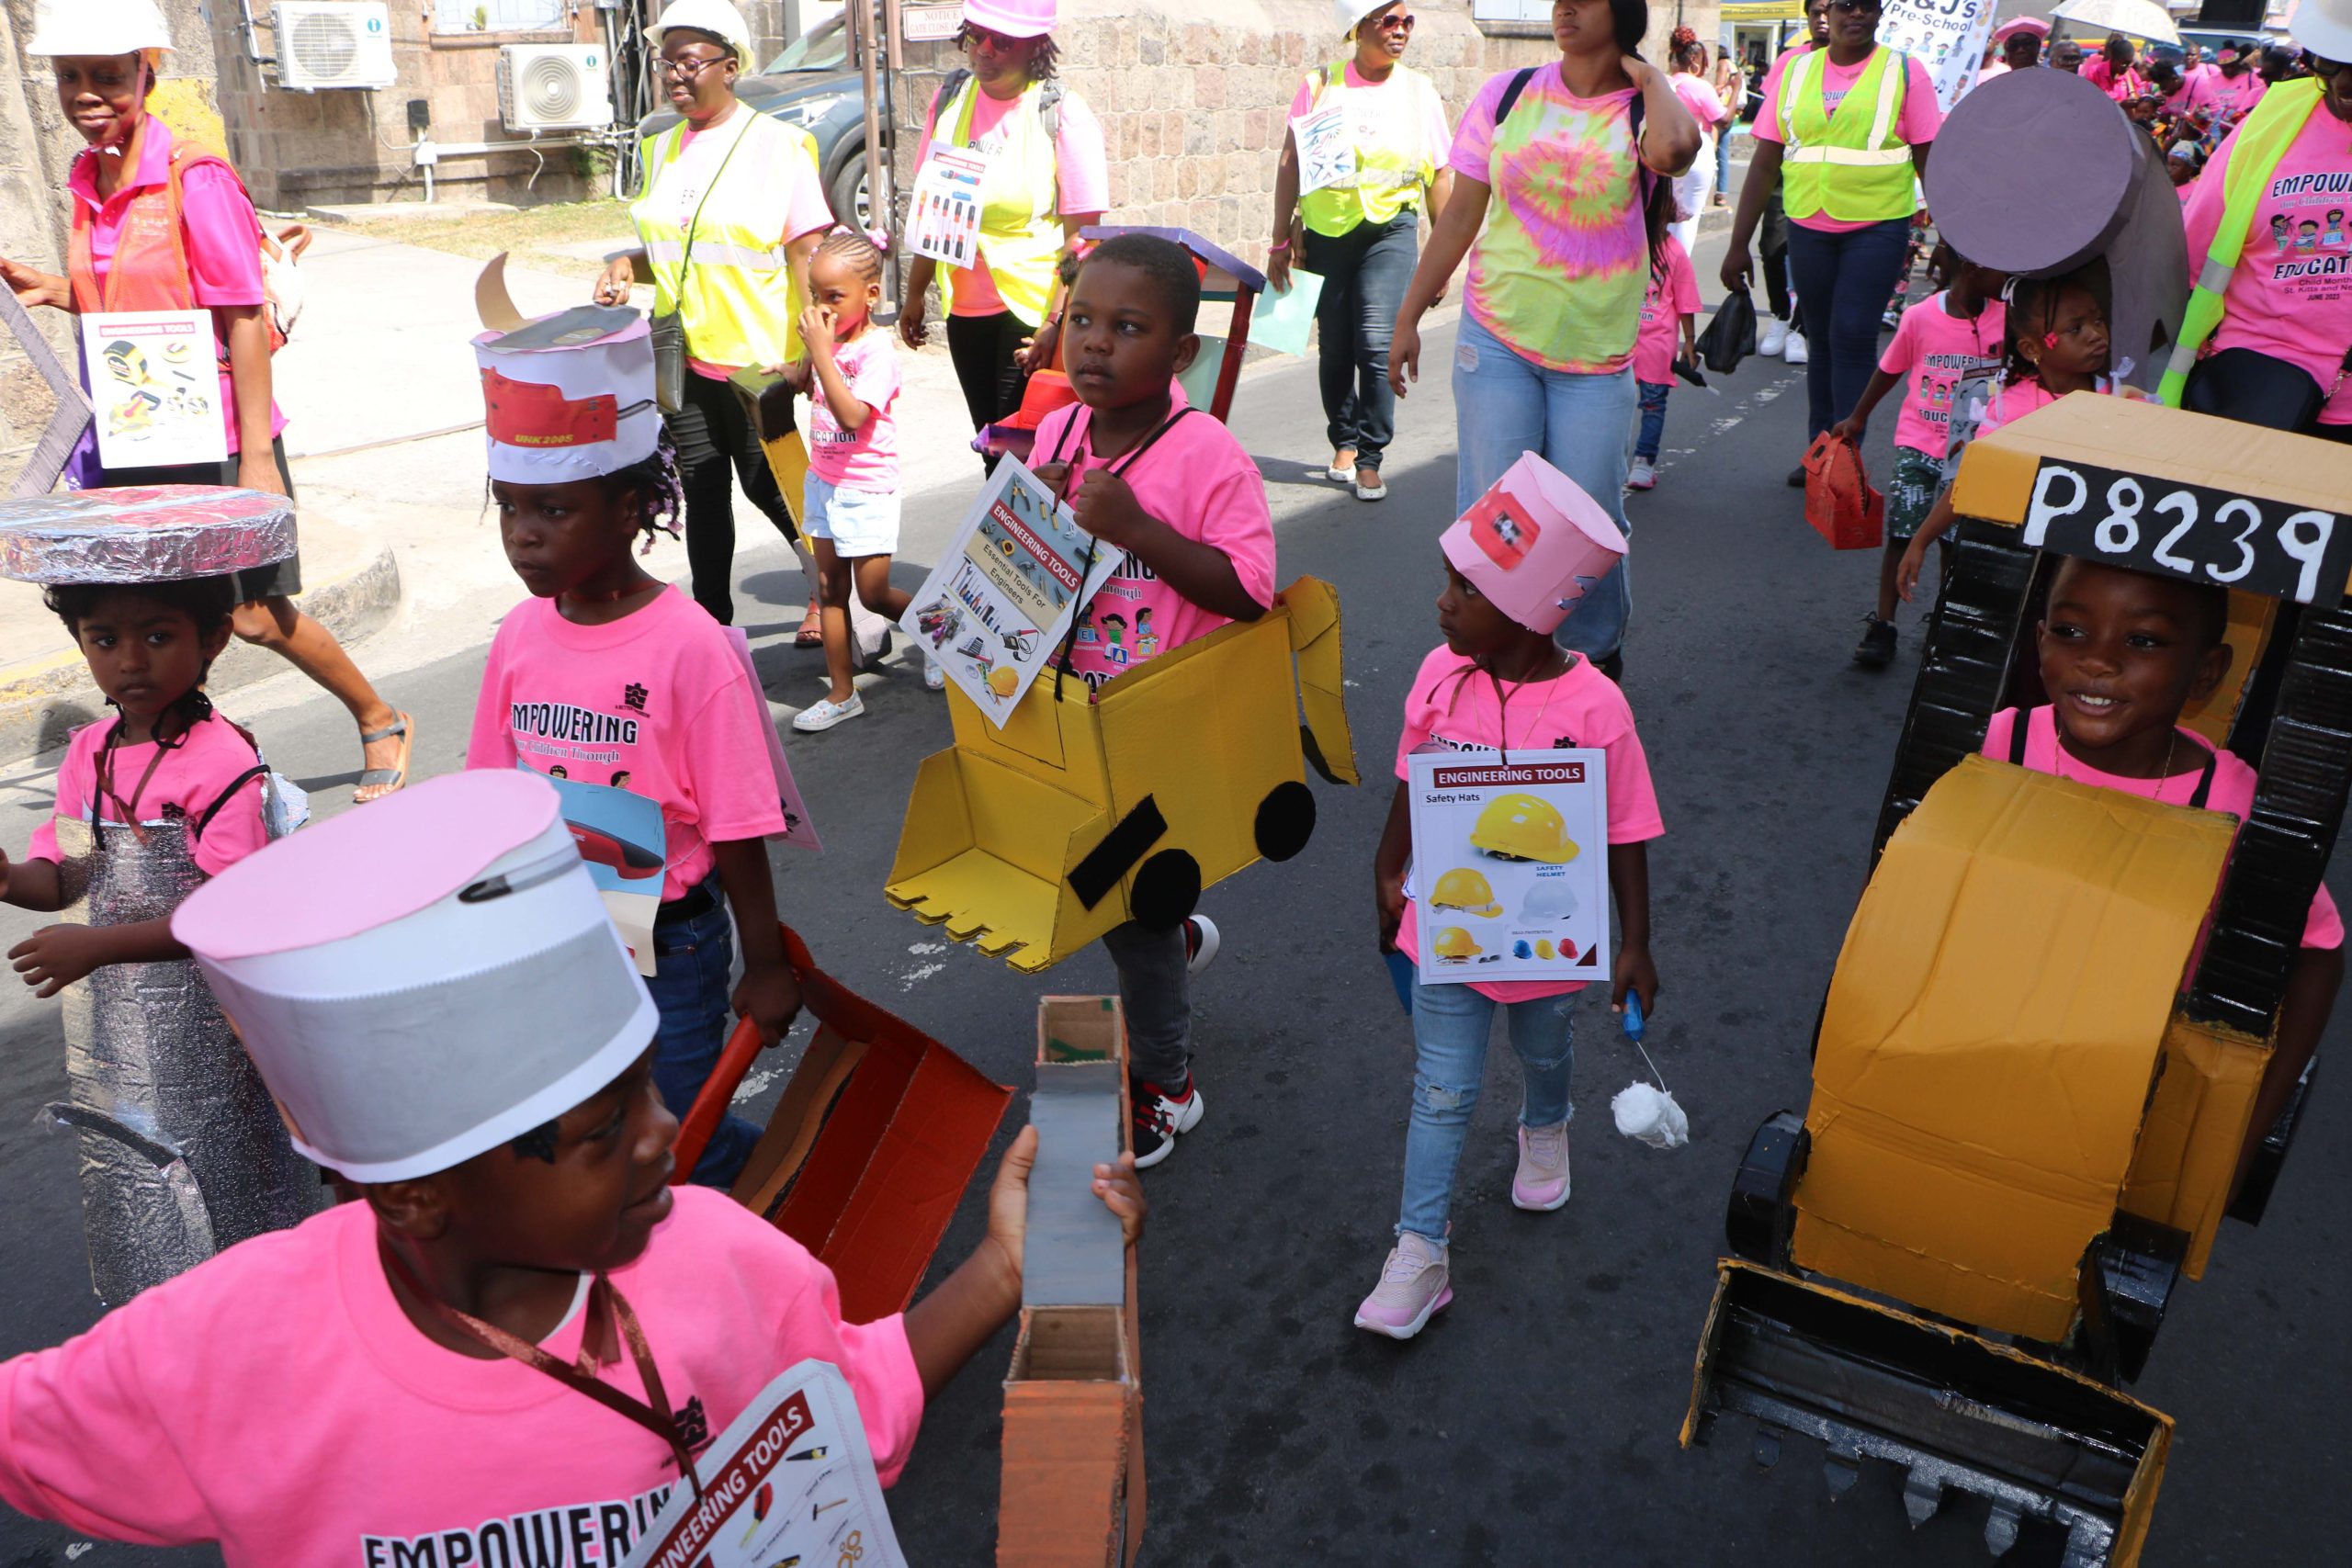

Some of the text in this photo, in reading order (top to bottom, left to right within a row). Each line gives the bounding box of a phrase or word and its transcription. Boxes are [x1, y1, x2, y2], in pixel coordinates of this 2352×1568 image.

[924, 10, 958, 20] NOTICE
[1890, 4, 1973, 32] Pre-School
[1899, 0, 1977, 18] &J's
[993, 504, 1079, 588] ENGINEERING TOOLS
[2023, 466, 2335, 604] P8239
[983, 544, 1046, 608] Essential Tools For
[989, 568, 1024, 604] Engineers
[511, 702, 638, 745] MPOWERING
[571, 746, 620, 764] Through
[1438, 768, 1581, 784] ENGINEERING TOOLS
[1426, 793, 1480, 804] Safety Hats
[653, 1469, 747, 1568] INEERING
[742, 1405, 804, 1477] TOOLS
